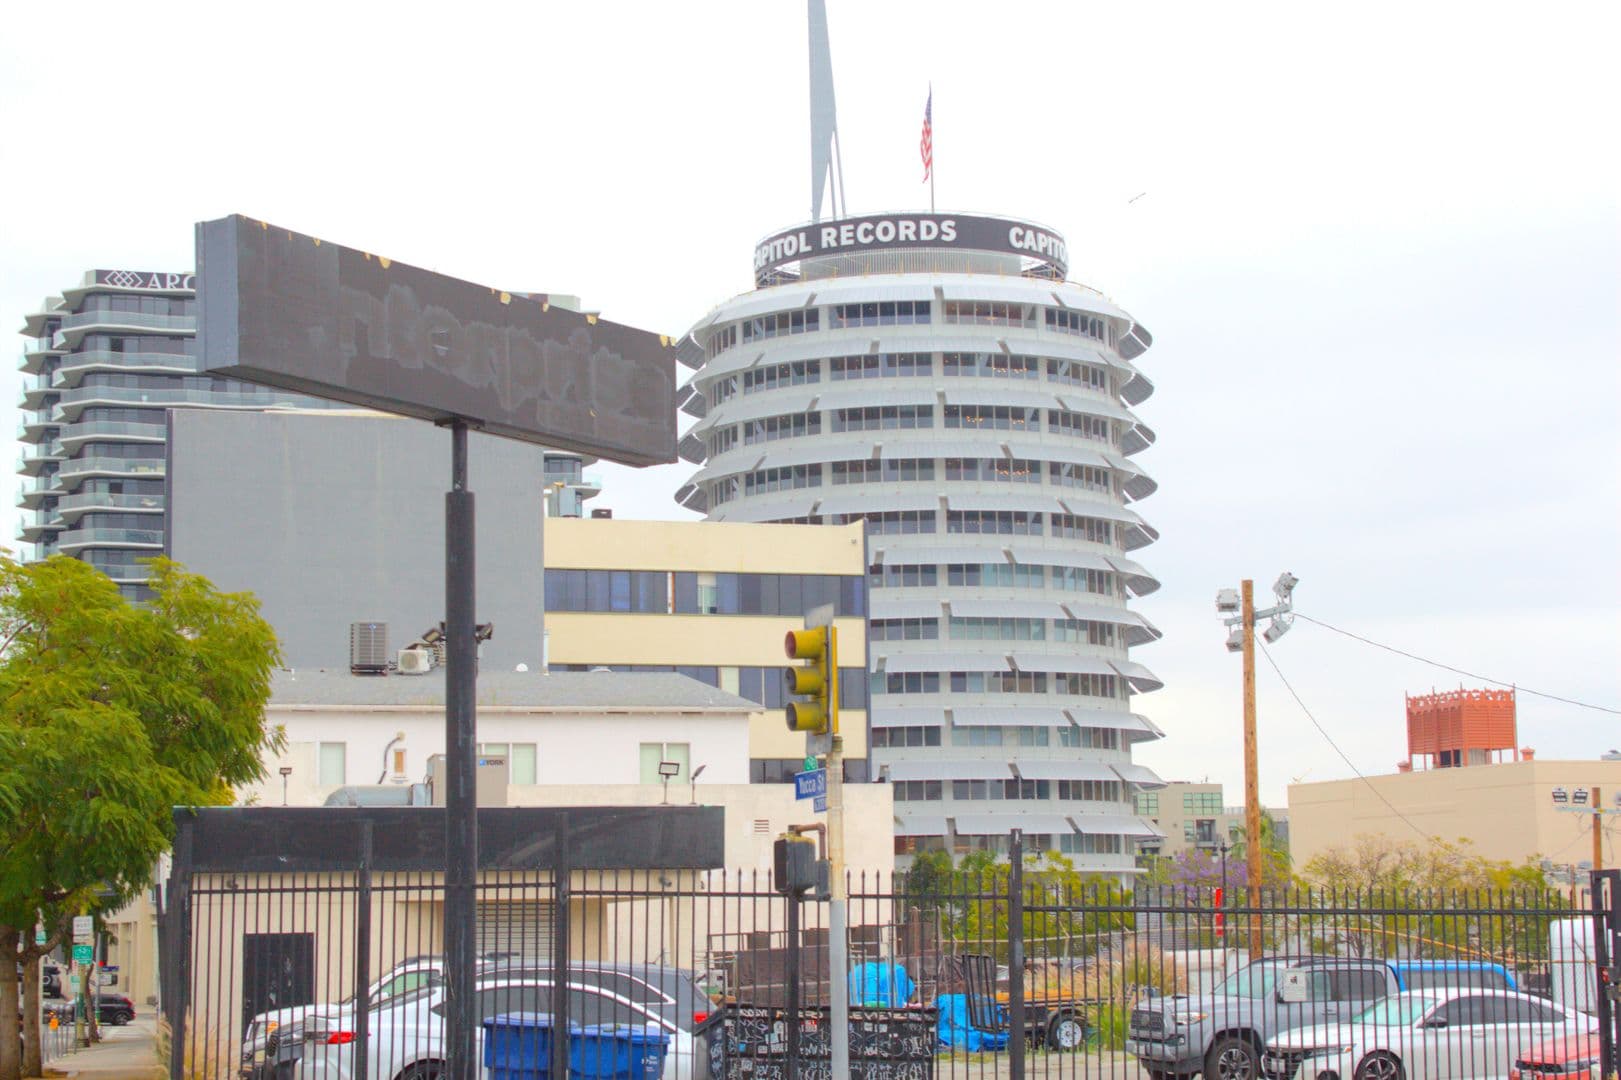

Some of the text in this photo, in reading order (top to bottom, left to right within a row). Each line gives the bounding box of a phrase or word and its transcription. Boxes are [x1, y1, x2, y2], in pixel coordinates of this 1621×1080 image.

[821, 220, 957, 249] RECORDS
[799, 773, 825, 794] Yucca St
